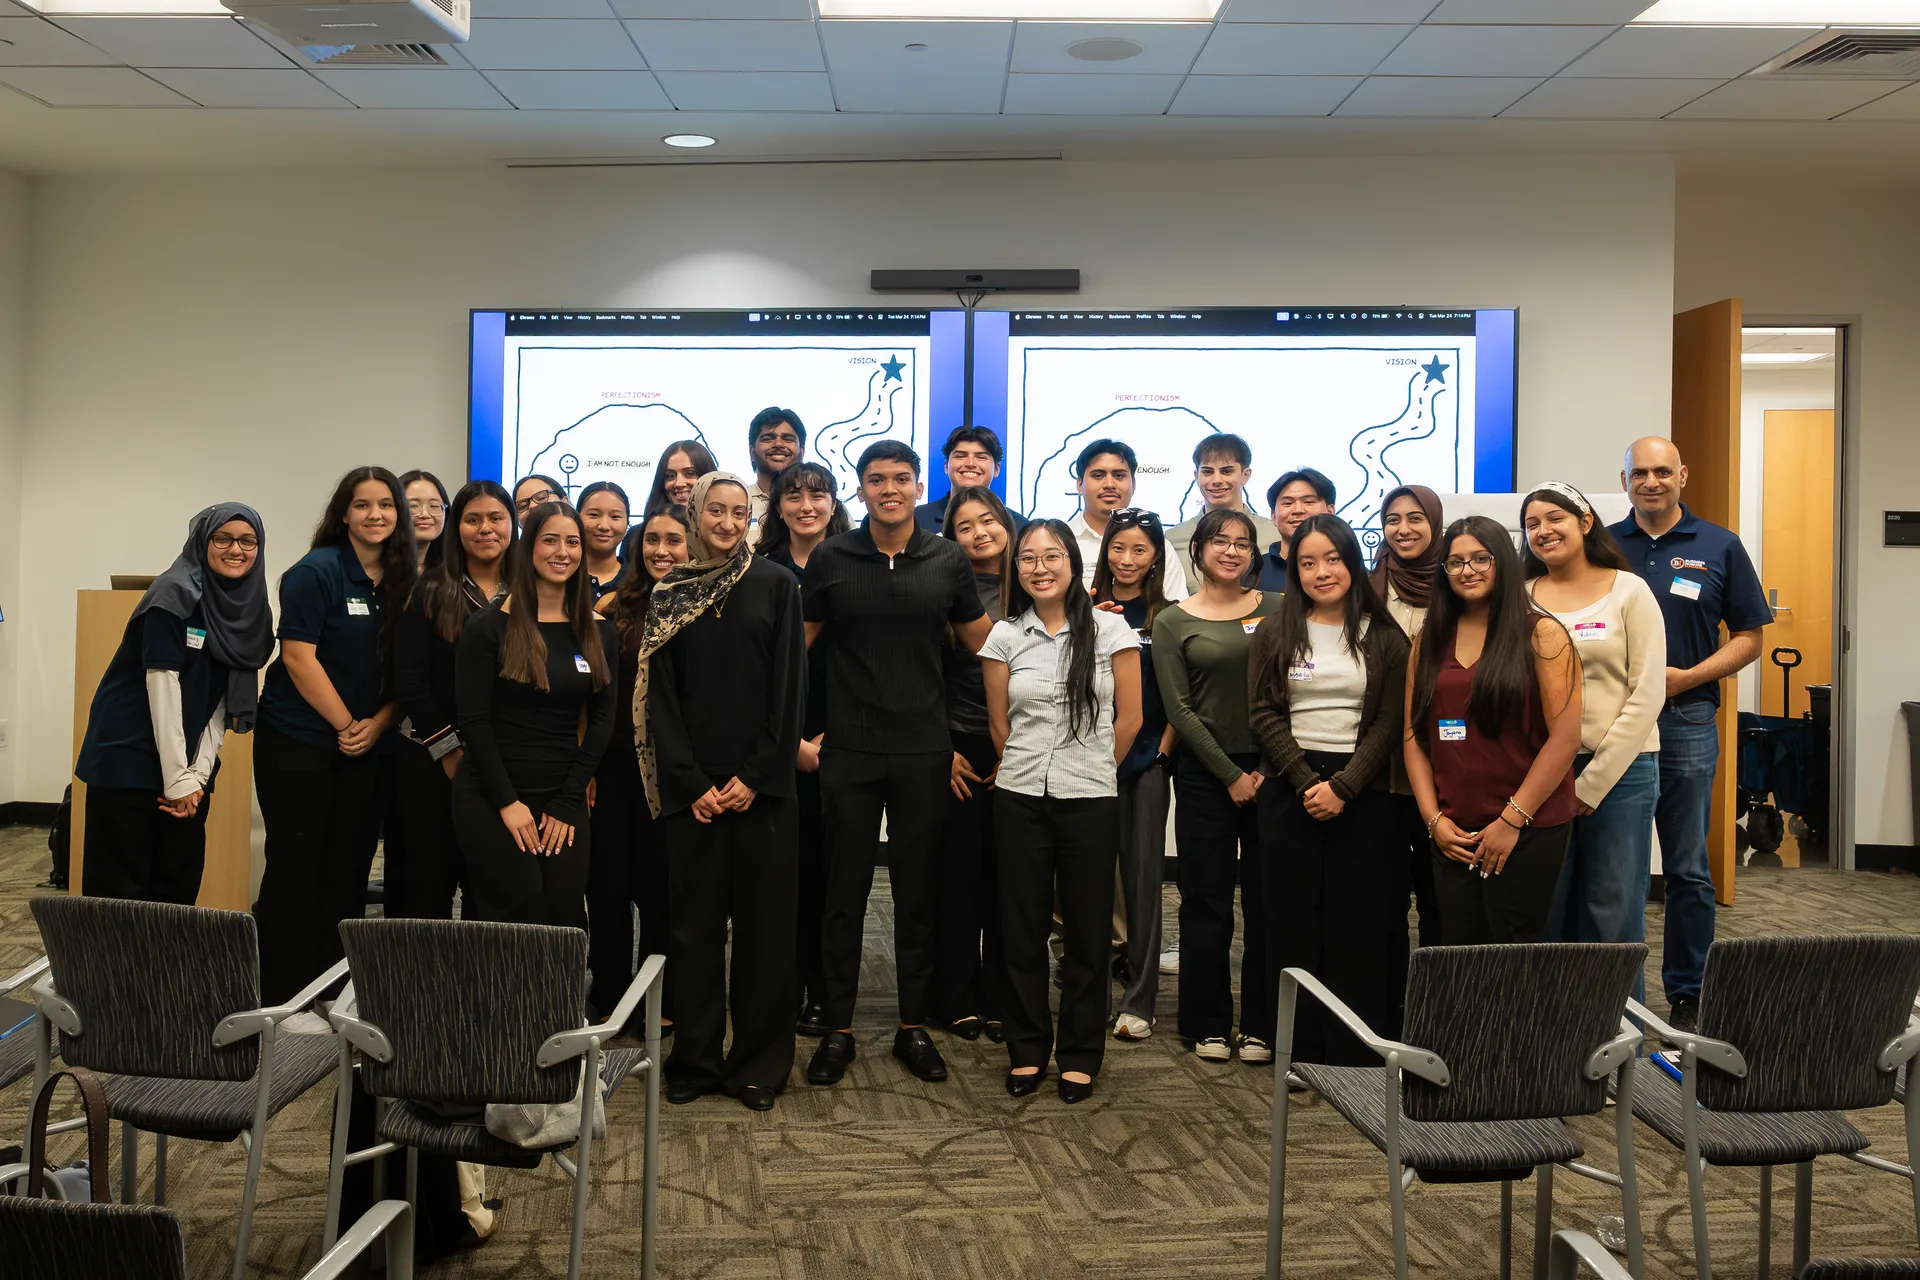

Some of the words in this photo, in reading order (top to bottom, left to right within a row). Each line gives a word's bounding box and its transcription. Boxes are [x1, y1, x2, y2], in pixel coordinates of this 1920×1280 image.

[848, 357, 877, 365] VISION
[1385, 358, 1417, 366] VISION
[601, 391, 661, 399] PERFECTIONISM
[1115, 394, 1181, 402] PERFECTIONISM
[621, 460, 651, 468] ENOUGH
[1137, 466, 1170, 474] ENOUGH
